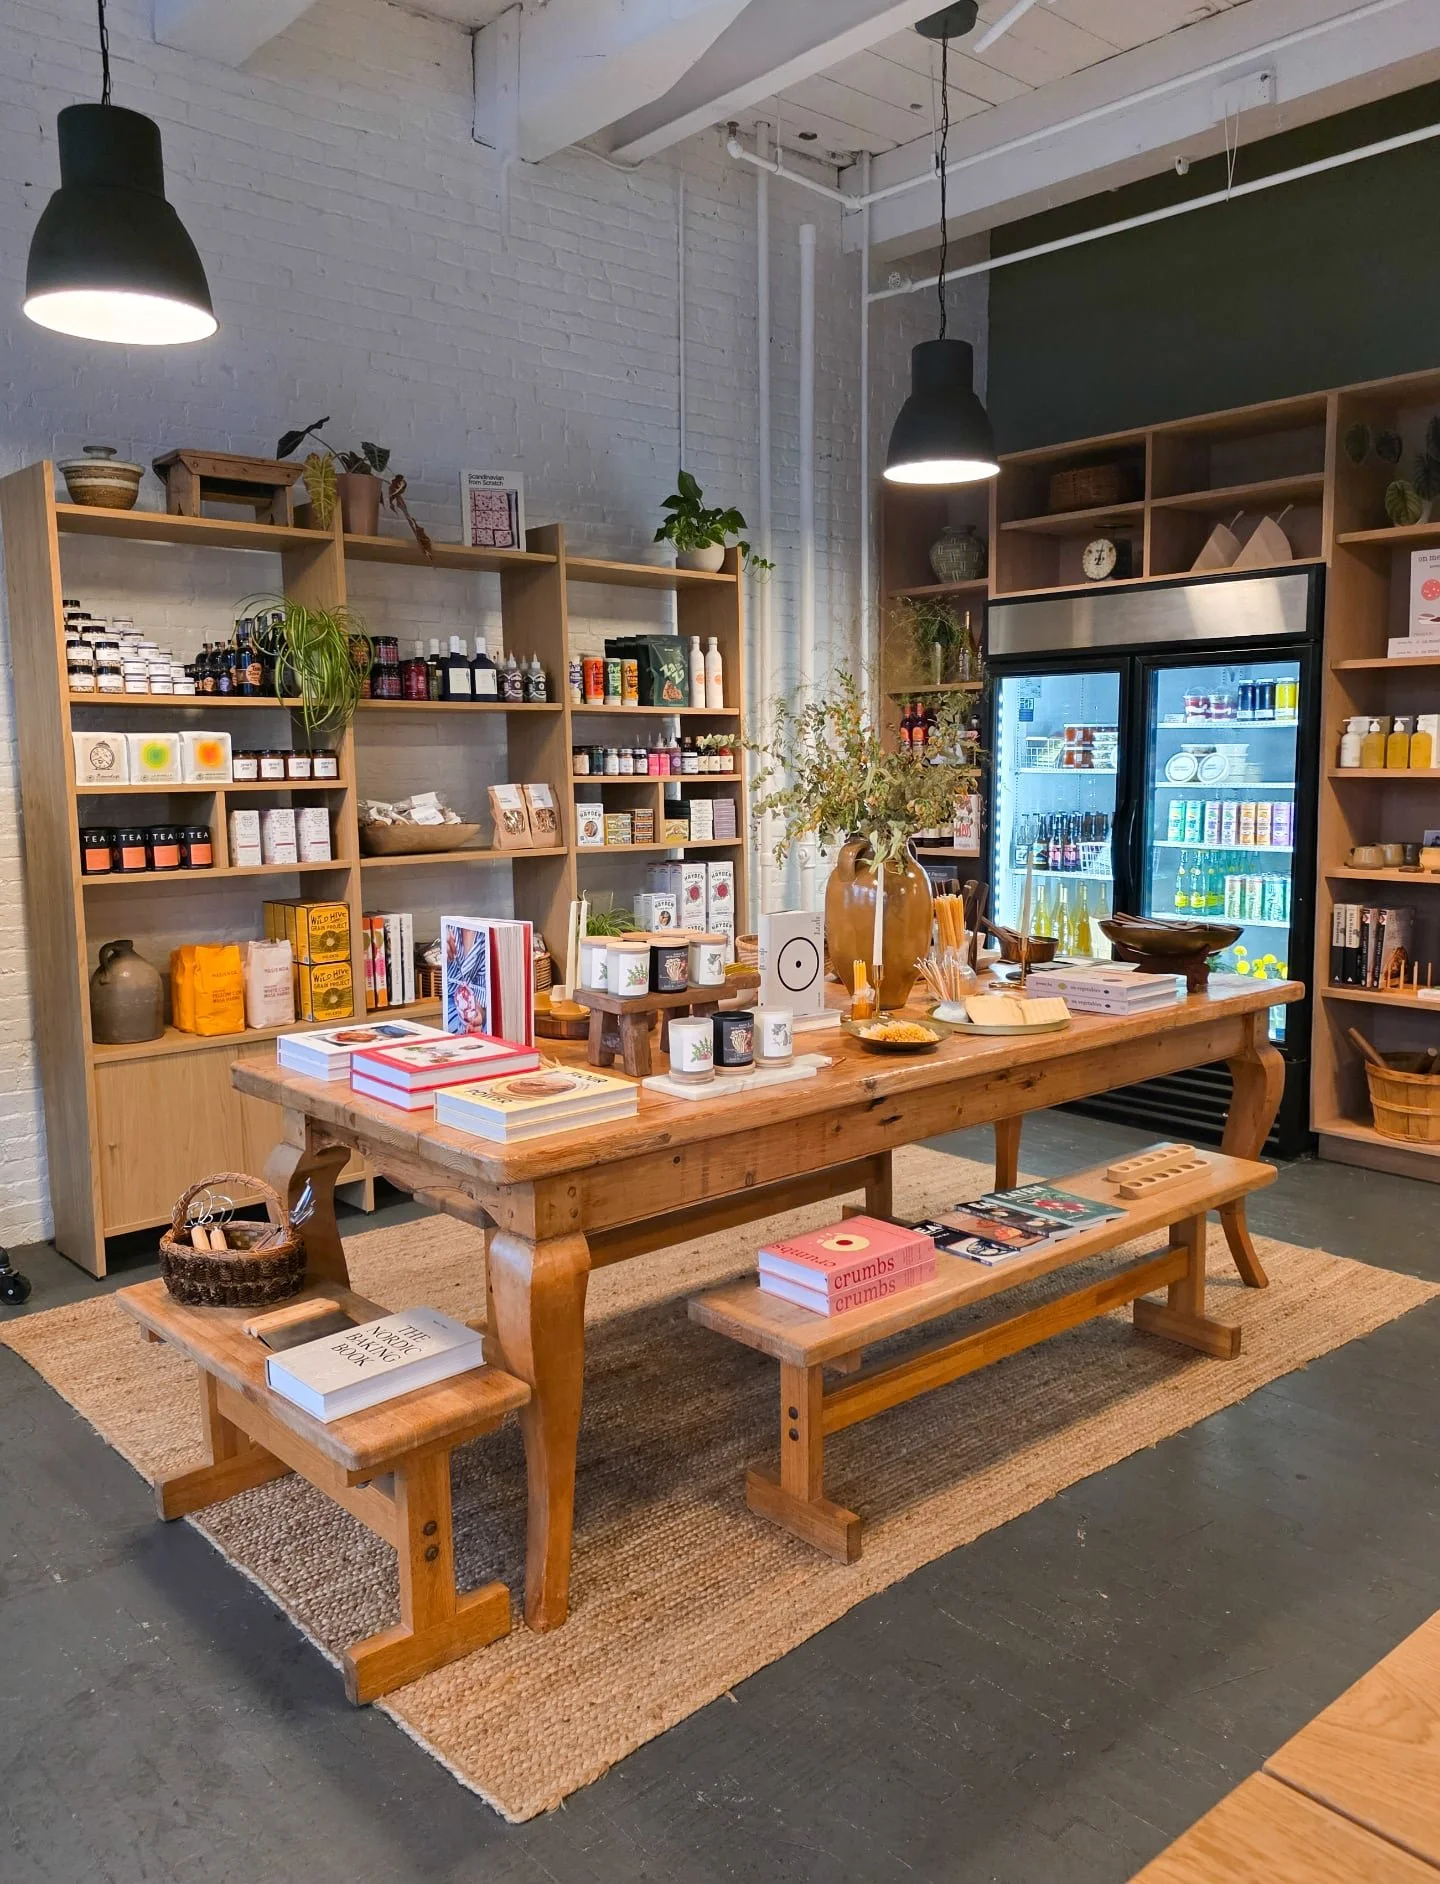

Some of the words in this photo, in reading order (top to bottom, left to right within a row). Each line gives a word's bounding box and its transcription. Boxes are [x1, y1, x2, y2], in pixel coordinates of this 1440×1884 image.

[468, 473, 505, 481] Scandinavian
[84, 835, 106, 843] TEA
[152, 833, 174, 841] TEA
[188, 831, 209, 839] TEA
[326, 921, 348, 929] PROJECT
[329, 979, 350, 987] PROJECT
[567, 1071, 608, 1083] FLOUR
[464, 1089, 513, 1105] POWER
[994, 1185, 1048, 1200] EATEN
[772, 1243, 837, 1268] crumbs
[834, 1256, 895, 1290] crumbs
[835, 1279, 896, 1312] crumbs
[366, 1325, 421, 1355] NORDIC
[397, 1324, 432, 1342] THE
[330, 1342, 376, 1367] BOOK
[345, 1332, 401, 1364] BAKING
